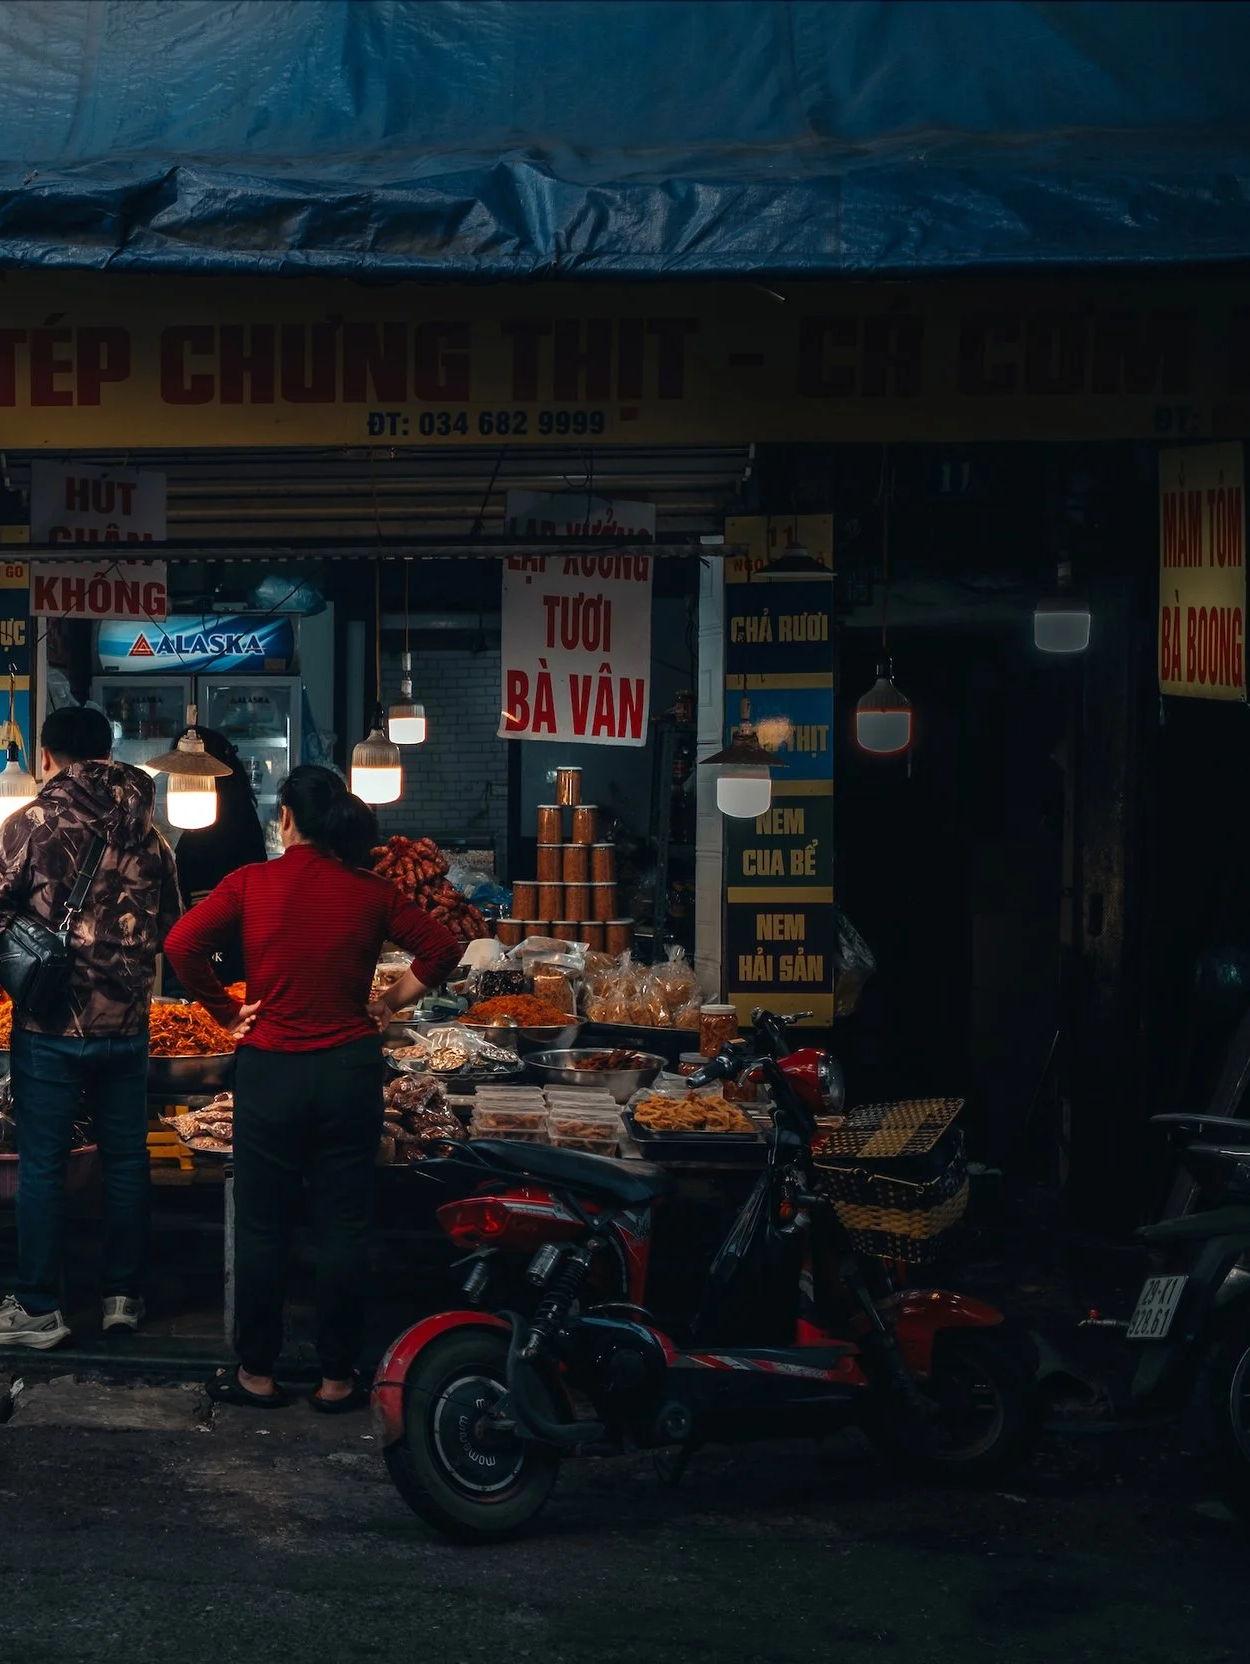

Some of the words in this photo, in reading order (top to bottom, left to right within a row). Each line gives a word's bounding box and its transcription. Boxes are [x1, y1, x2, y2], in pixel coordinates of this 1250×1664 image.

[159, 313, 472, 405] CHƯNG
[500, 317, 700, 421] THỊT
[367, 412, 410, 437] ĐT:
[419, 411, 469, 437] 034
[479, 410, 528, 436] 682
[539, 410, 606, 436] 9999
[66, 472, 138, 516] HÚT
[1207, 470, 1242, 568] TÔM
[34, 571, 166, 616] KHÔNG
[543, 592, 612, 653] TƯƠI
[730, 607, 774, 643] CHẢ
[778, 611, 829, 642] RƯƠI
[1161, 589, 1182, 682] BÀ
[1187, 606, 1243, 687] BOONG
[155, 633, 266, 656] ALASKA
[505, 658, 557, 733] BÀ
[569, 663, 645, 739] VÂN
[756, 808, 805, 835] NEM
[742, 849, 785, 876] CUA
[790, 838, 819, 876] BỂ
[756, 914, 806, 941] NEM
[738, 947, 774, 982] HẢI
[779, 946, 824, 982] SẢN
